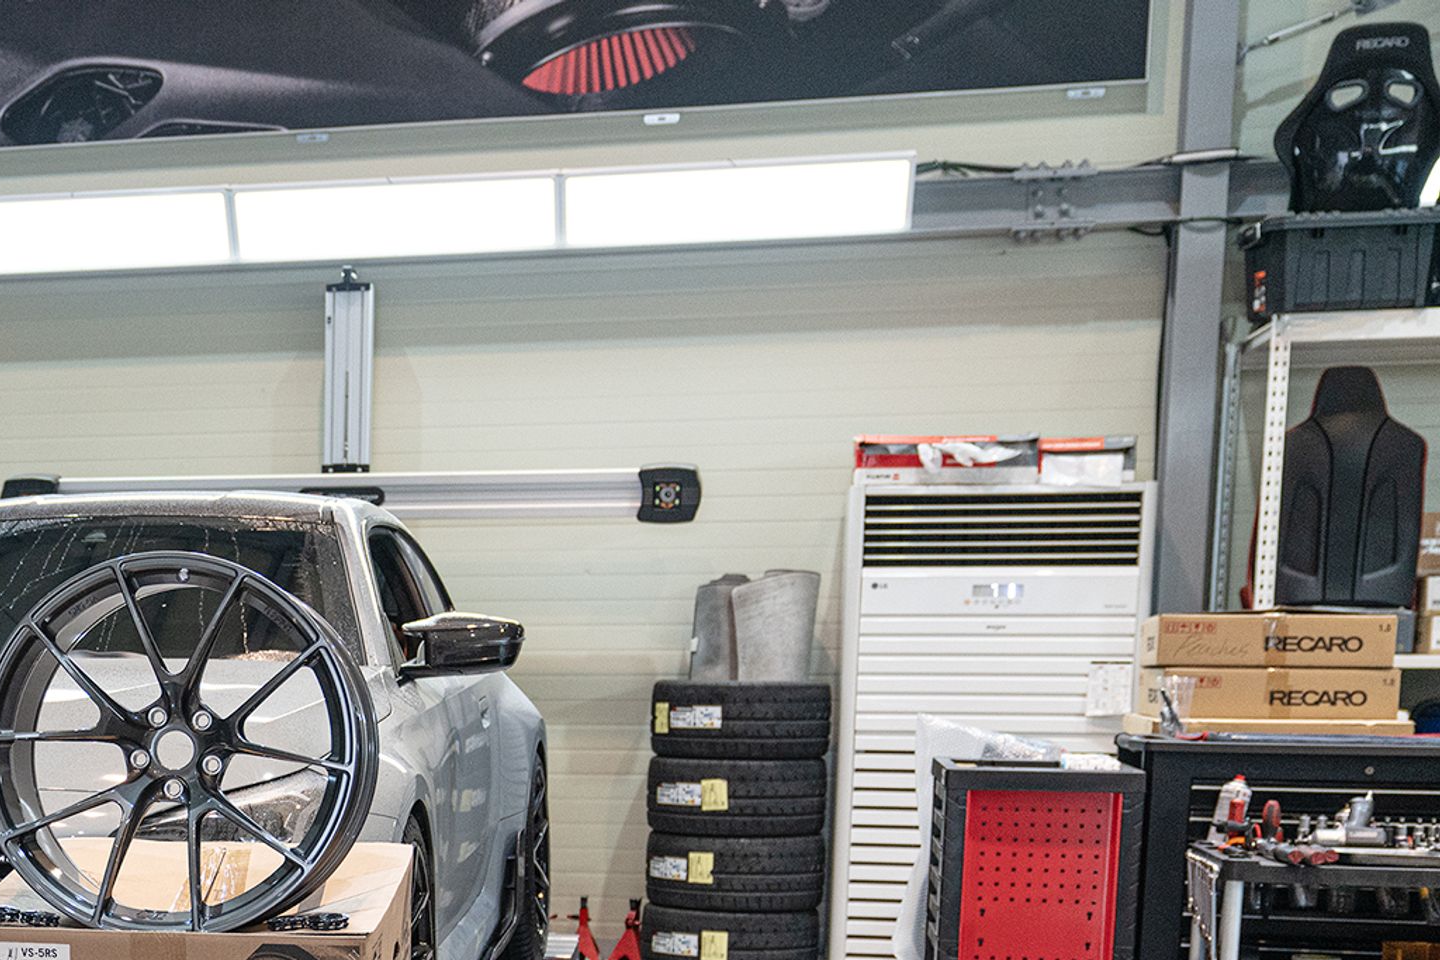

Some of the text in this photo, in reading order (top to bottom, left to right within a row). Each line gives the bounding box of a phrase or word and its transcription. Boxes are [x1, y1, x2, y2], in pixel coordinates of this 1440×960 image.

[1264, 636, 1363, 652] RECARO
[1269, 690, 1367, 706] RECARO
[21, 948, 58, 958] VS-5RS
